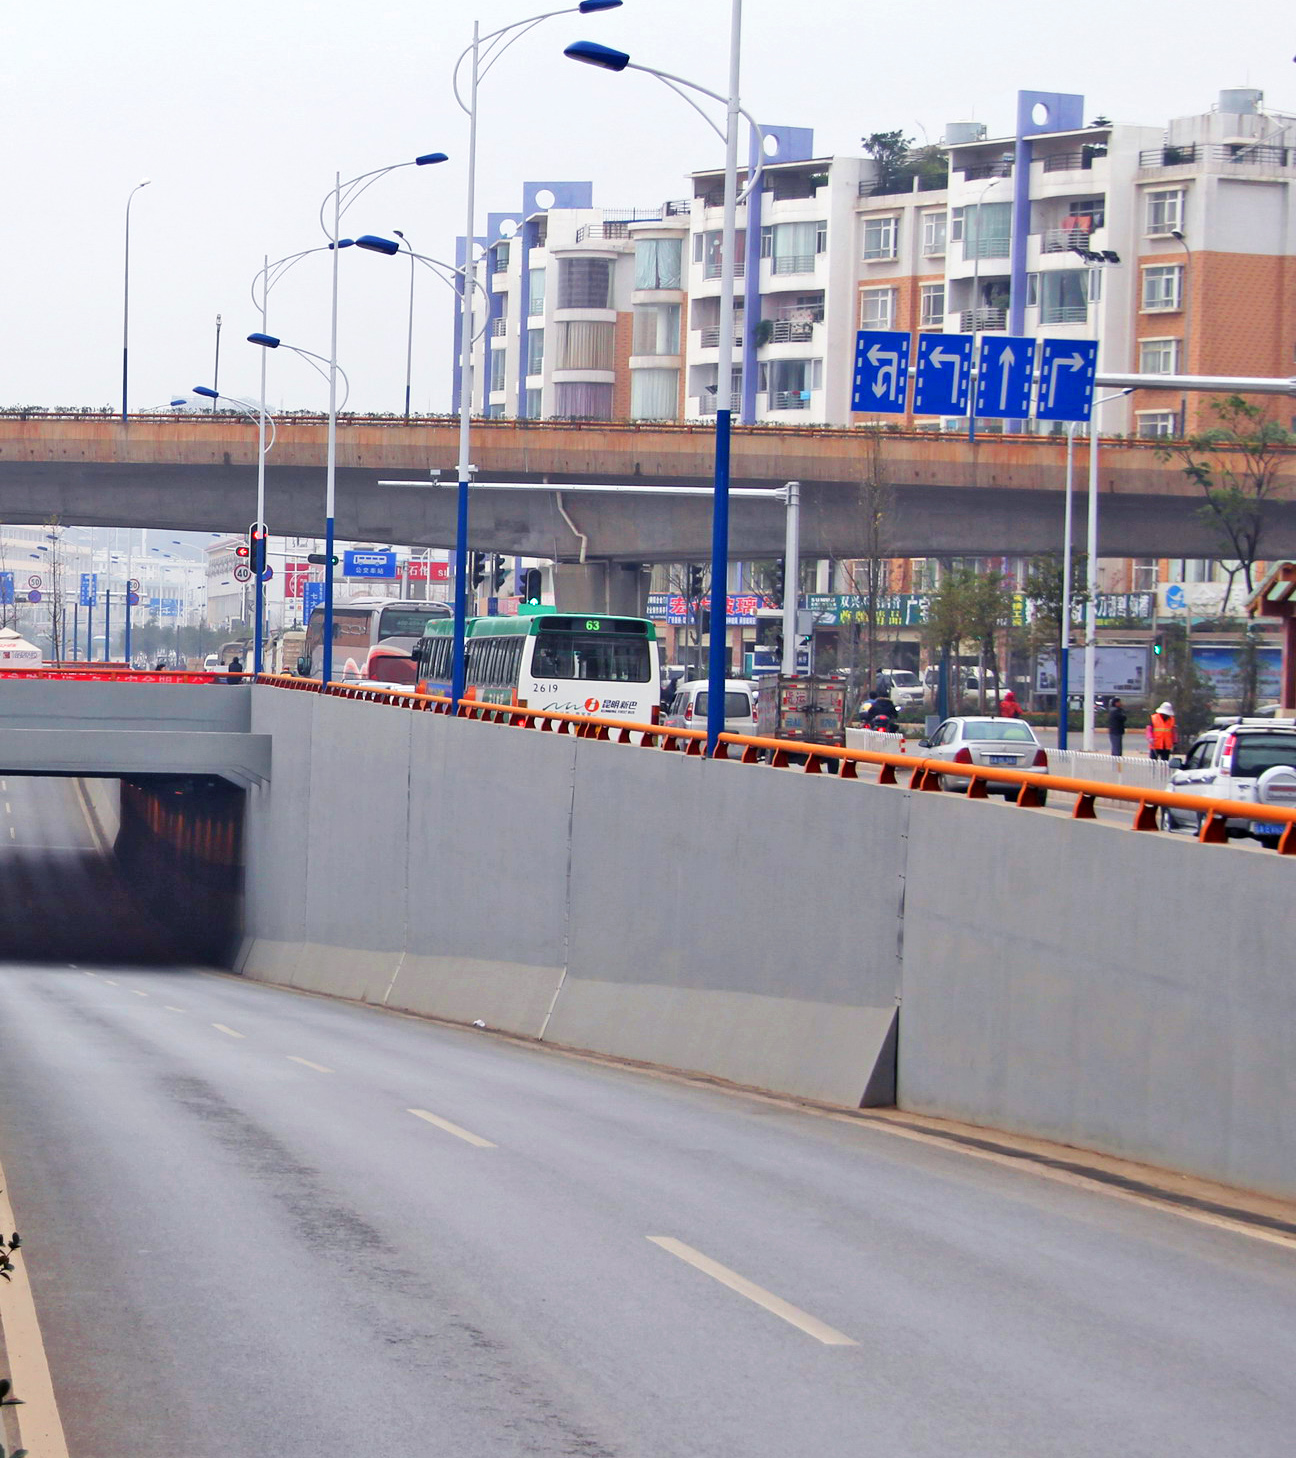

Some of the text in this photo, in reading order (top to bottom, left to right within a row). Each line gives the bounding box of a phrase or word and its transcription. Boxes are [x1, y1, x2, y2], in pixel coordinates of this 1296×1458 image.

[237, 569, 248, 578] 40
[355, 567, 384, 575] 公交车站
[31, 577, 40, 586] 50
[586, 620, 600, 631] 63
[533, 683, 558, 693] 2619
[601, 699, 638, 710] 昆明新巴
